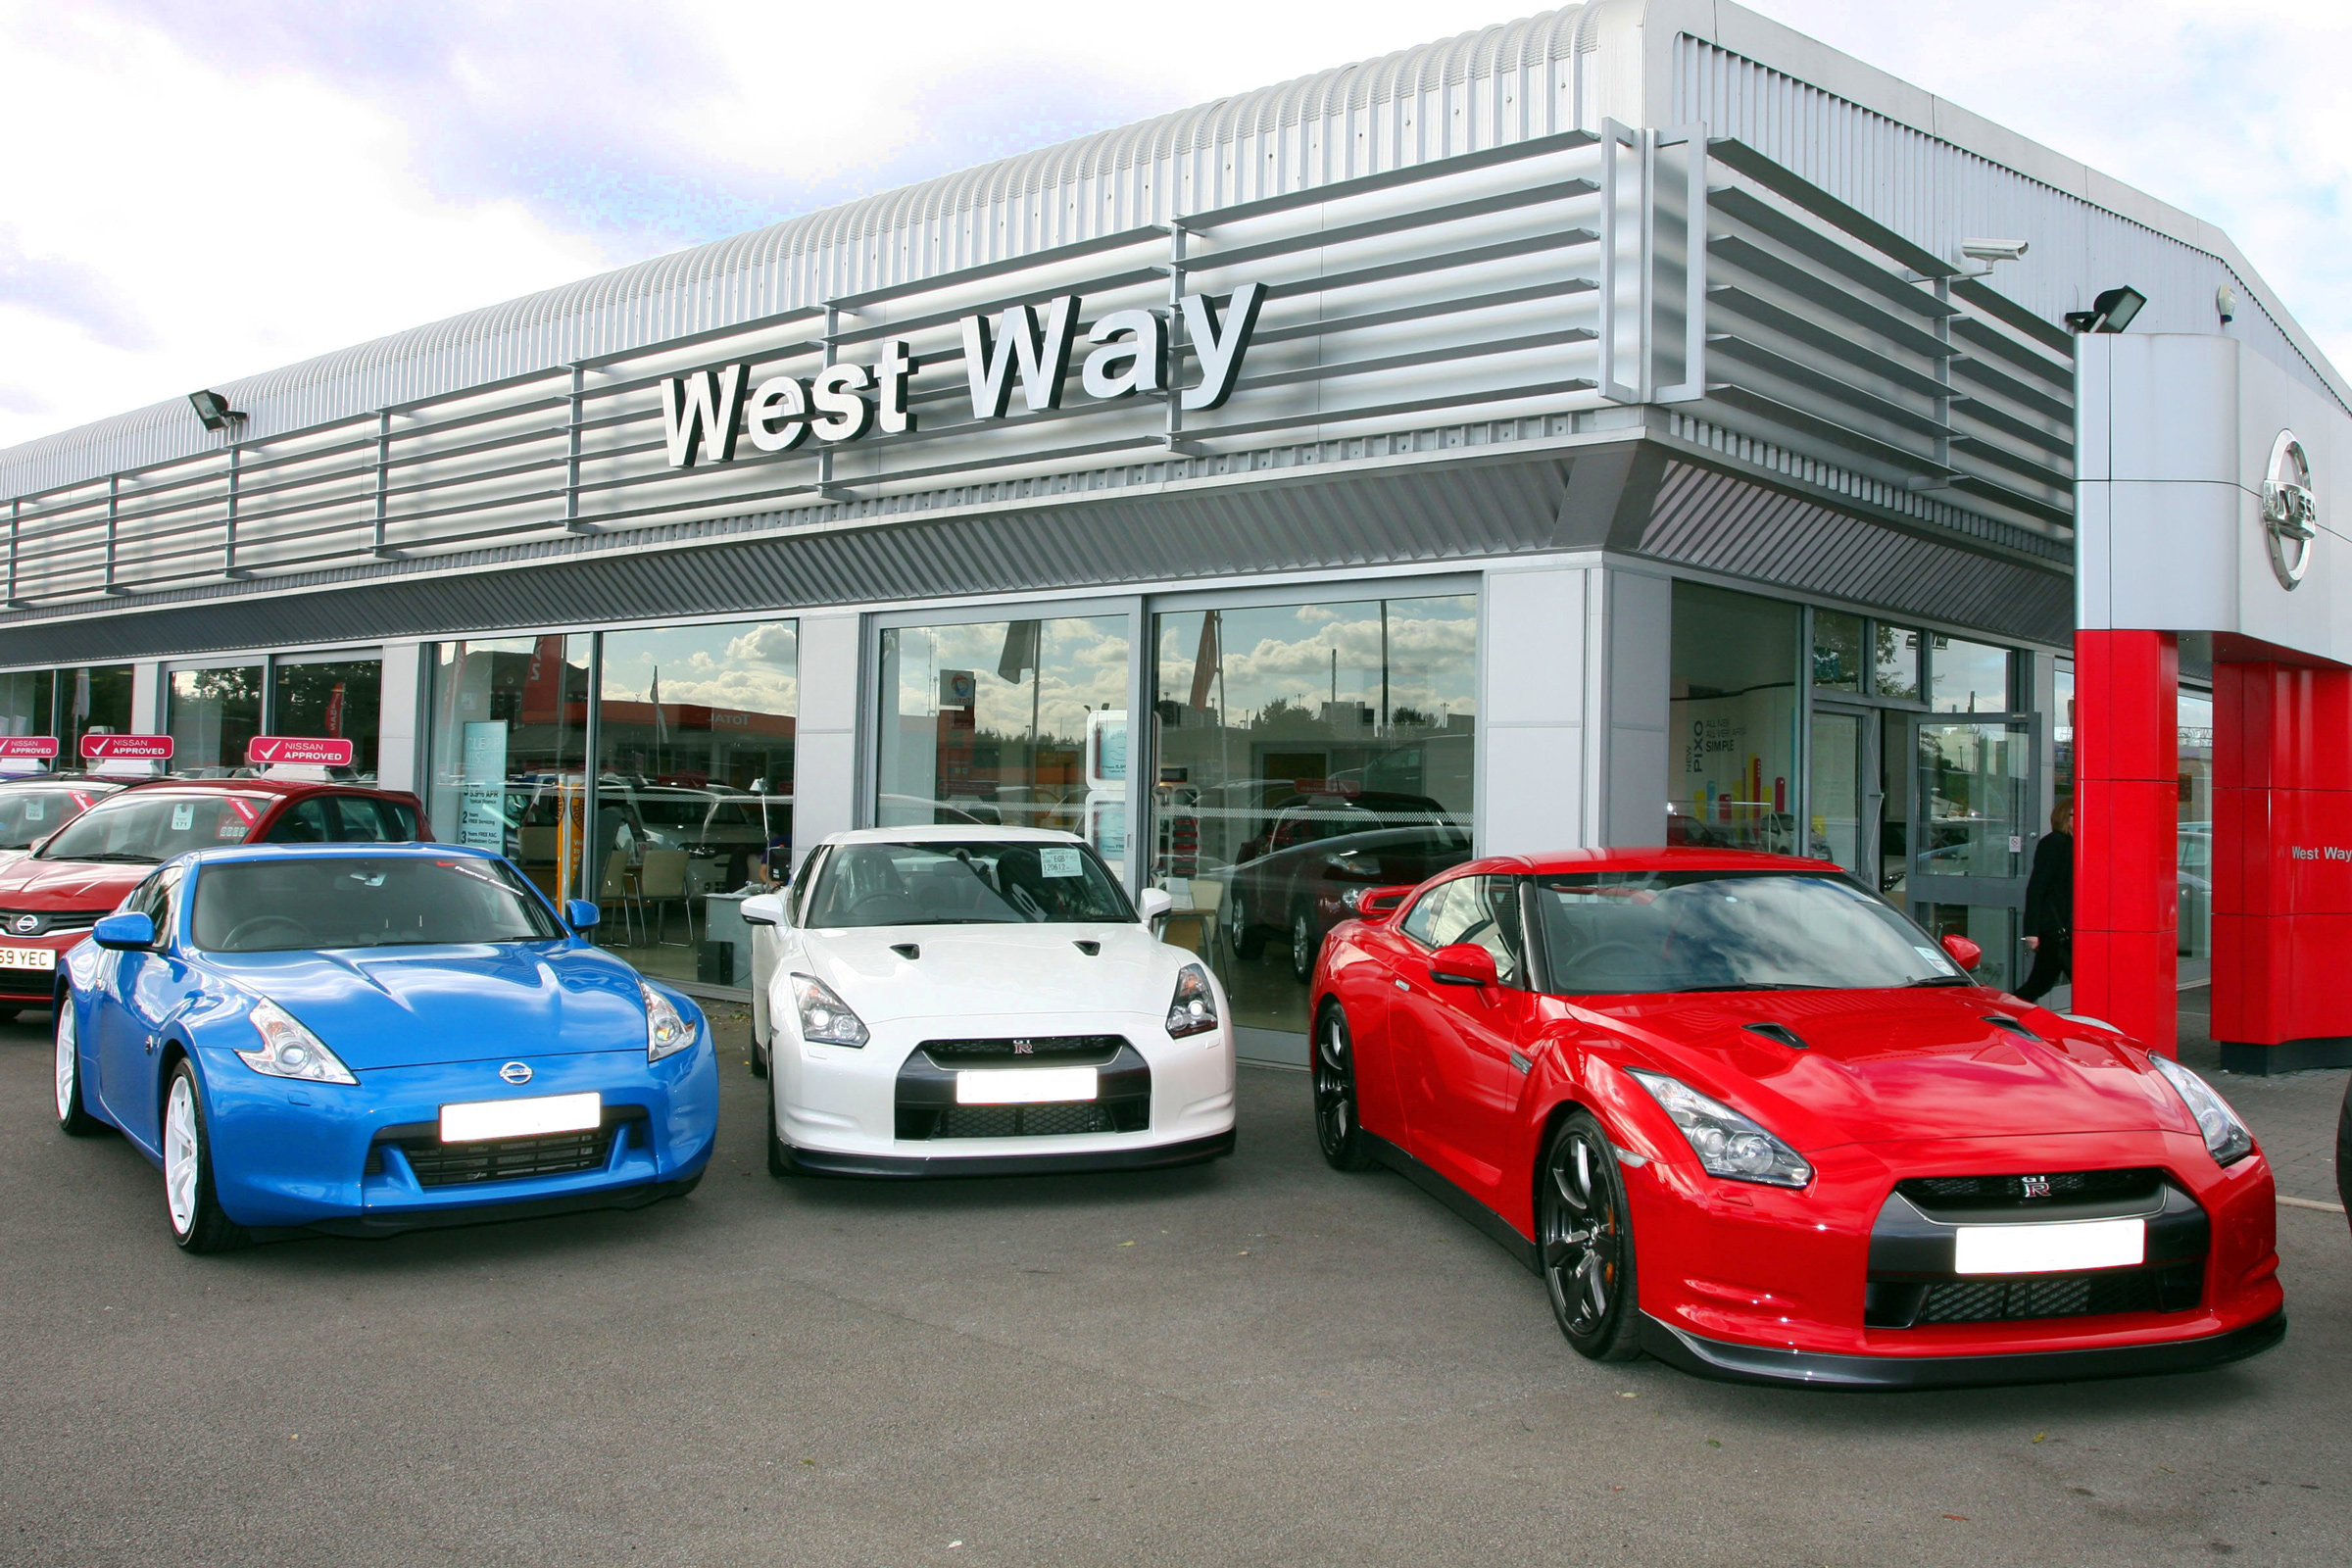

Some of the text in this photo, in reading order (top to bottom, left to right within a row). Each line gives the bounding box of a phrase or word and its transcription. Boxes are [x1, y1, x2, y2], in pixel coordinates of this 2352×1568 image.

[661, 281, 1268, 467] West Way
[285, 742, 324, 751] NISSAN
[1693, 720, 1703, 772] PIXO
[1705, 739, 1735, 752] SIMPLE
[283, 751, 343, 760] APPROVED
[463, 810, 468, 823] 2
[461, 830, 467, 844] 3
[2291, 846, 2352, 862] West Way
[20, 951, 47, 966] YEC
